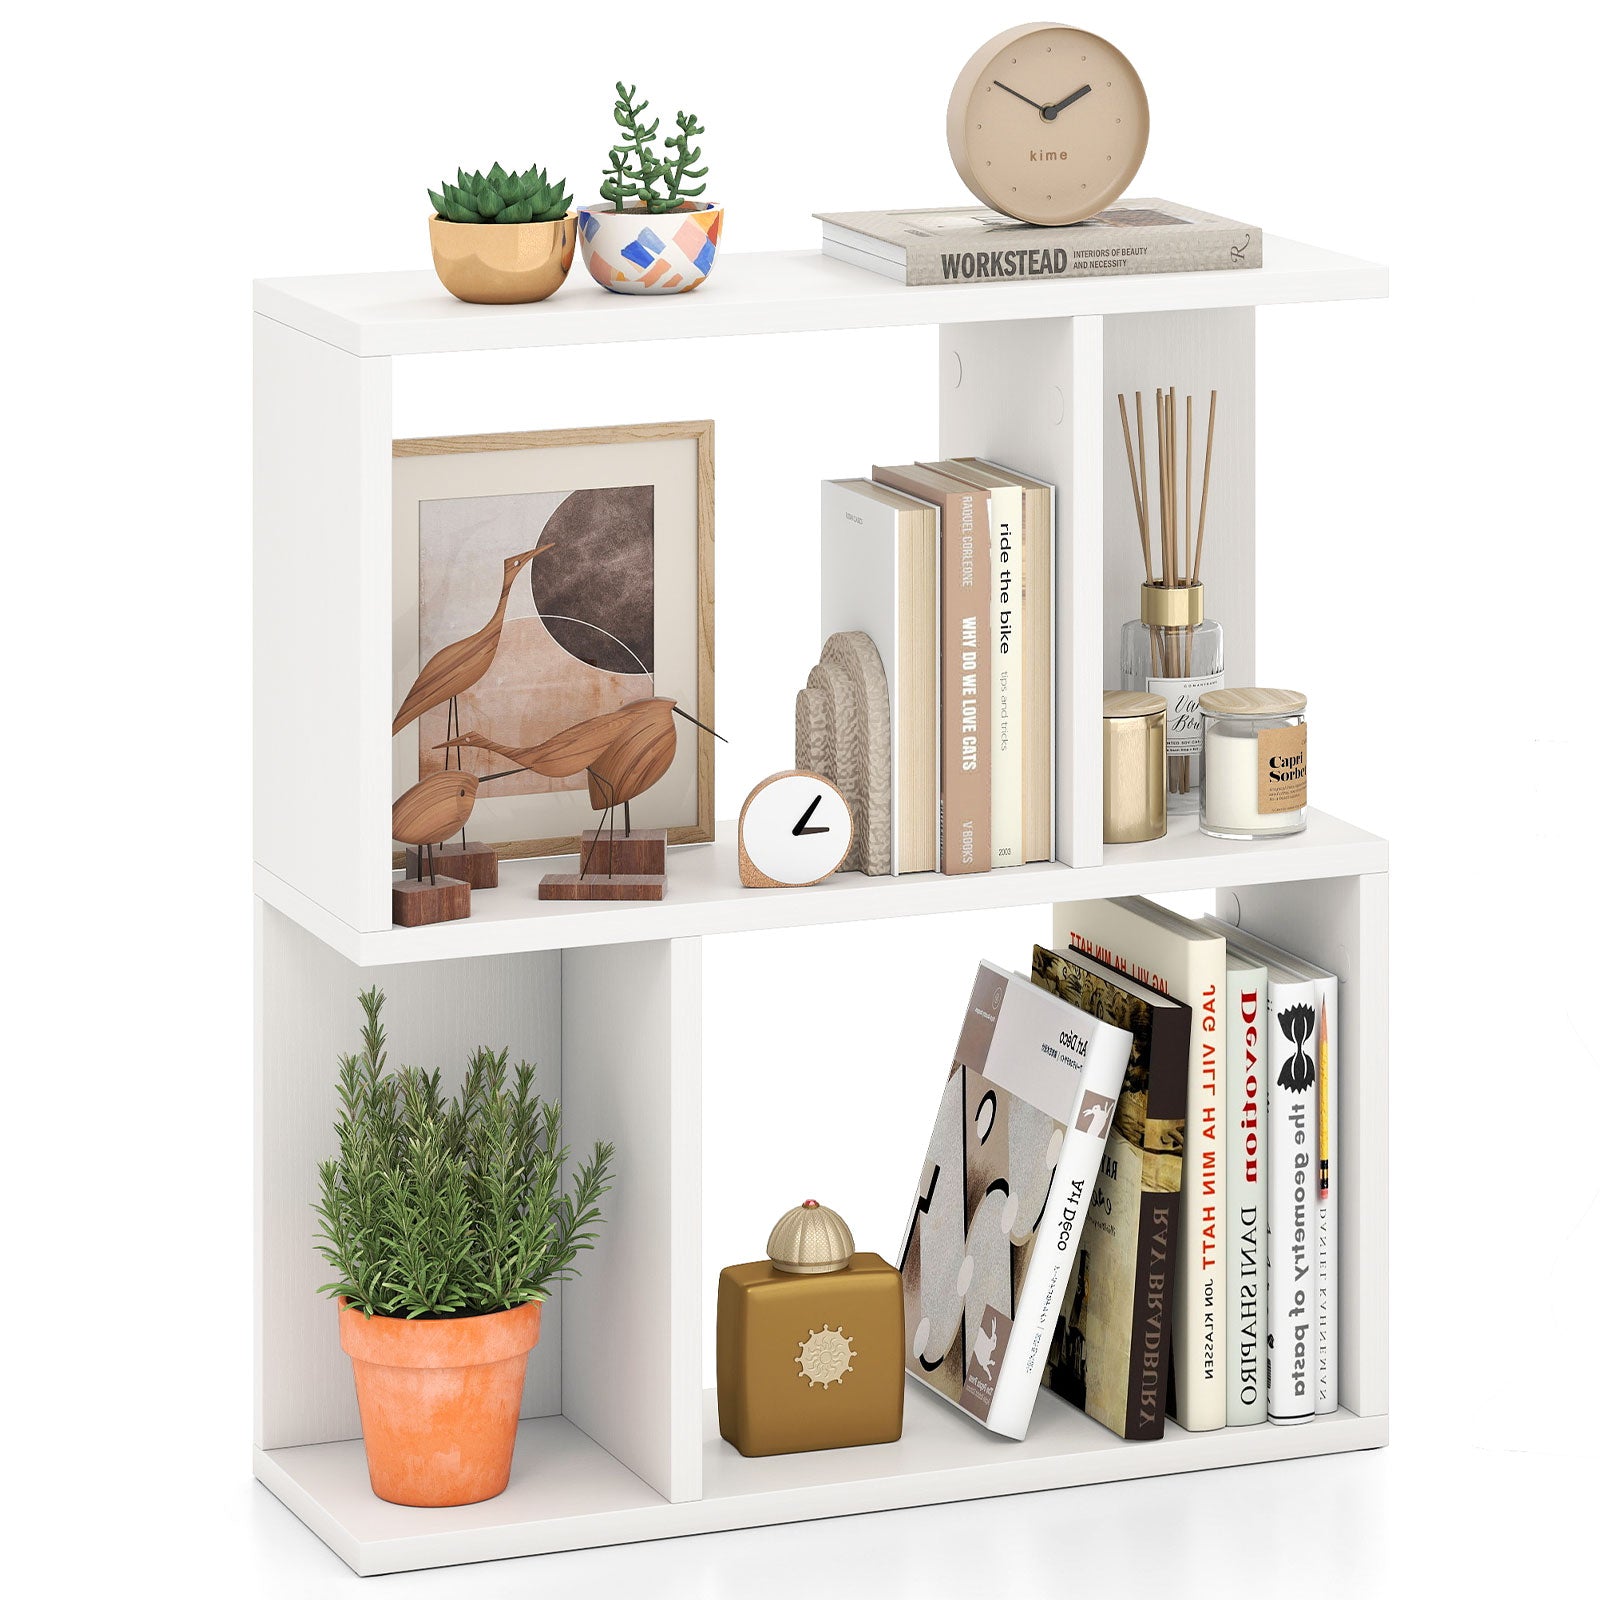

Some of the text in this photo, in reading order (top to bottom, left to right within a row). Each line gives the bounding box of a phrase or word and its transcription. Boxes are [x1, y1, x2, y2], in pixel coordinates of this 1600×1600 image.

[1029, 149, 1068, 162] kime
[941, 248, 1068, 280] WORKSTEAD
[1073, 247, 1148, 258] INTERIORS OF BEAUTY
[1073, 259, 1127, 270] AND NECESSITY
[962, 495, 973, 587] RAQUEL CORLEONE
[1000, 523, 1012, 654] ride the bike
[962, 616, 977, 771] WHY DO WE LOVE CATS
[1000, 671, 1009, 751] tips and tricks
[1269, 752, 1303, 770] Capri
[998, 848, 1012, 856] 2003
